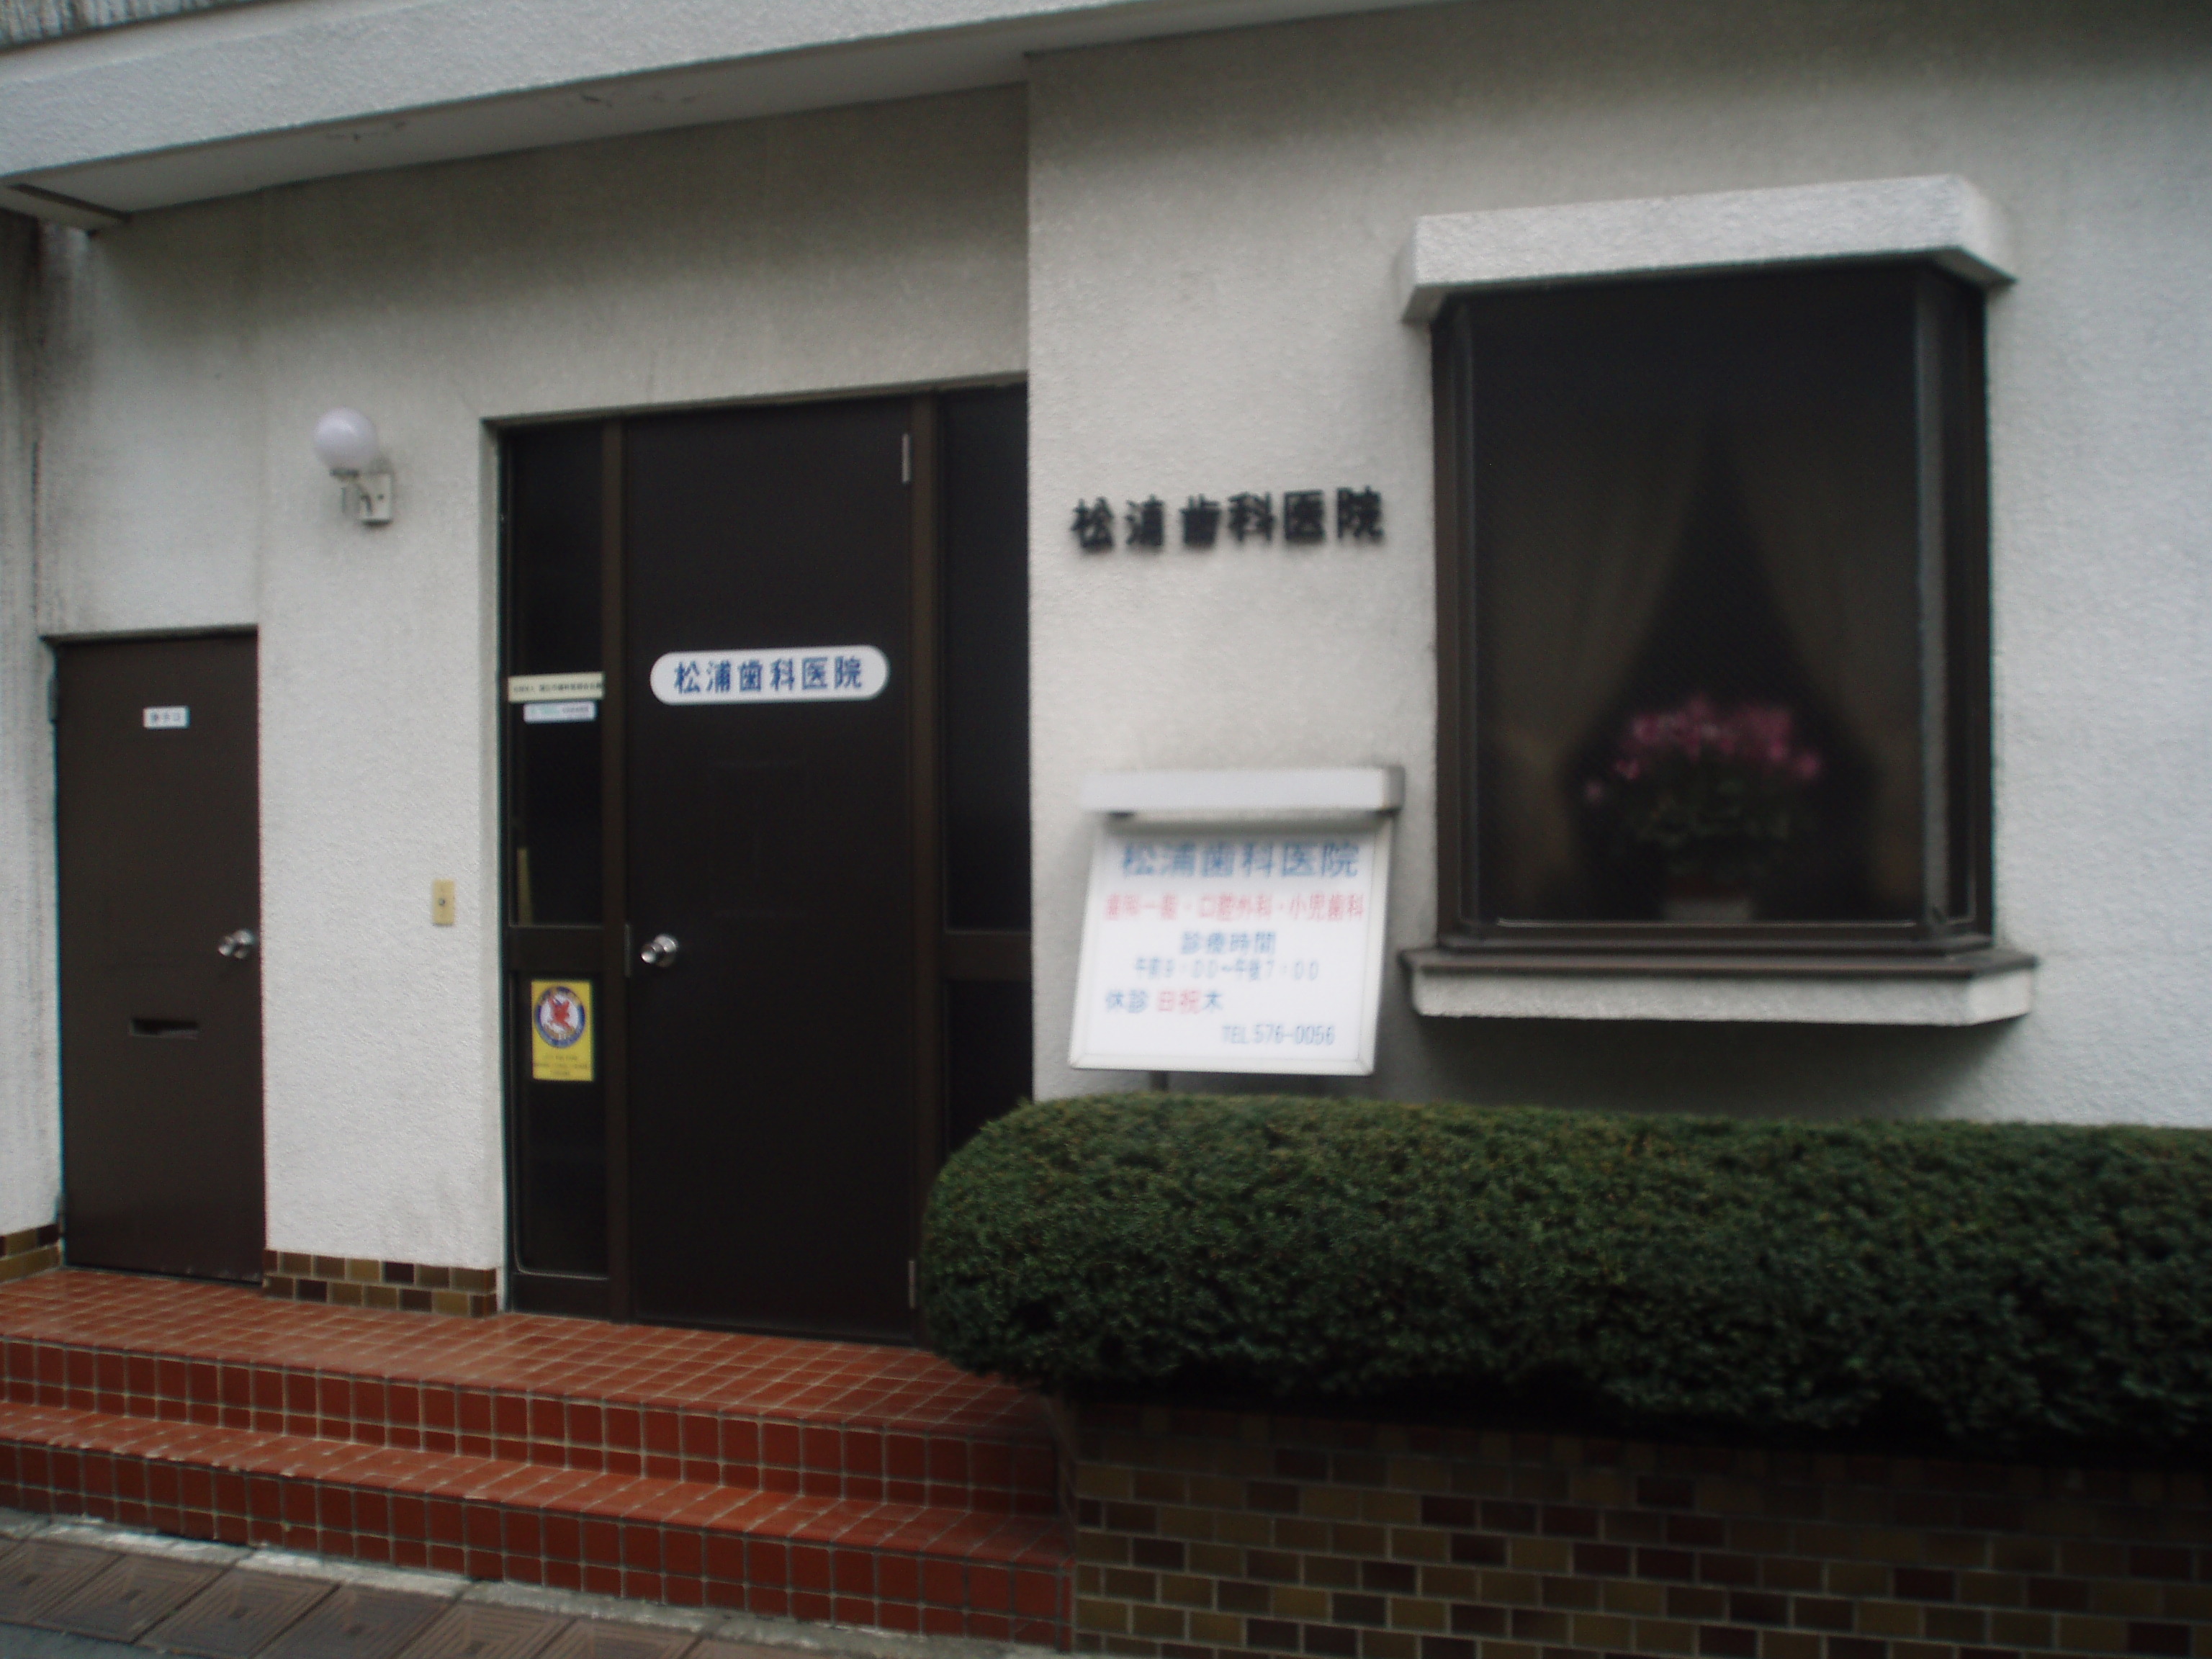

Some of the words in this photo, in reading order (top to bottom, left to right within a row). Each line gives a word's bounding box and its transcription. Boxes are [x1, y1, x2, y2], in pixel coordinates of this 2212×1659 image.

[1071, 485, 1384, 552] 松浦歯科医院
[673, 655, 863, 694] 松浦歯科医院
[1123, 841, 1359, 877] 松浦歯科医院
[1181, 931, 1277, 955] 診療時間
